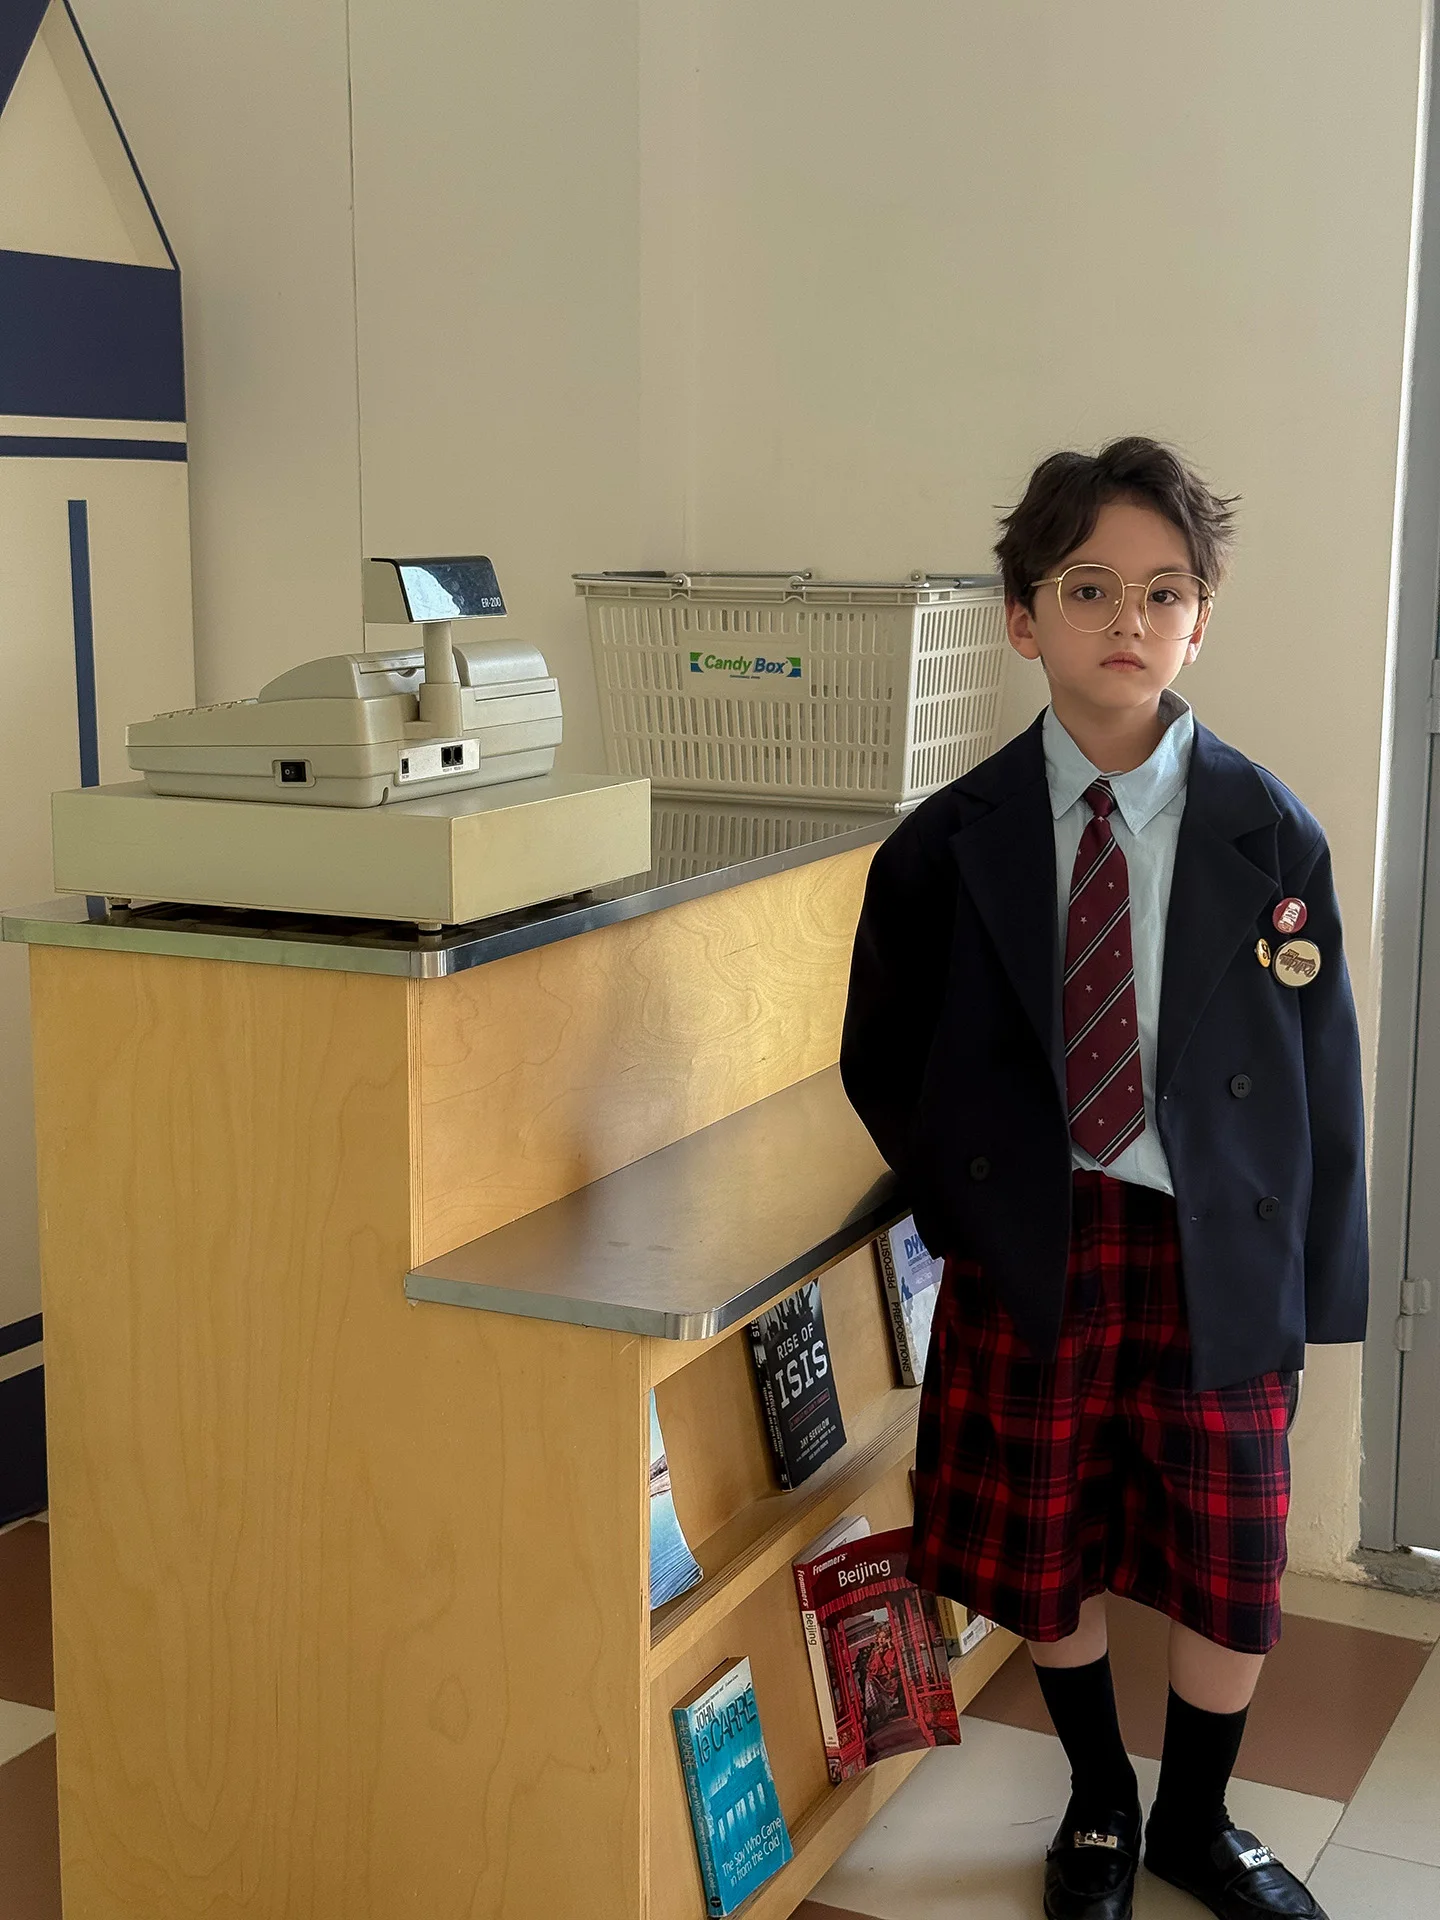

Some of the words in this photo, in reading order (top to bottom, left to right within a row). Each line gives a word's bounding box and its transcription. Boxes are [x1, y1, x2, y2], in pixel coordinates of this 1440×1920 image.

[481, 597, 501, 608] ER-200
[704, 655, 752, 675] Candy
[753, 657, 785, 674] Box
[776, 1333, 800, 1361] RISE
[801, 1322, 814, 1342] OF
[891, 1301, 911, 1373] PREPOSITIONS
[775, 1340, 828, 1409] ISIS
[799, 1436, 809, 1450] JAY
[812, 1553, 846, 1576] Frommer's
[837, 1559, 892, 1588] Beijing
[797, 1569, 809, 1609] Frommer's
[804, 1613, 818, 1646] Beijing
[695, 1701, 717, 1733] JOHN
[696, 1733, 713, 1766] le
[710, 1682, 757, 1752] CARRÉ
[722, 1860, 734, 1877] The
[734, 1850, 746, 1867] Spy
[744, 1834, 762, 1855] Who
[760, 1817, 782, 1840] Came
[730, 1875, 738, 1888] in
[736, 1861, 753, 1881] from
[751, 1850, 764, 1867] the
[762, 1835, 780, 1856] Cold
